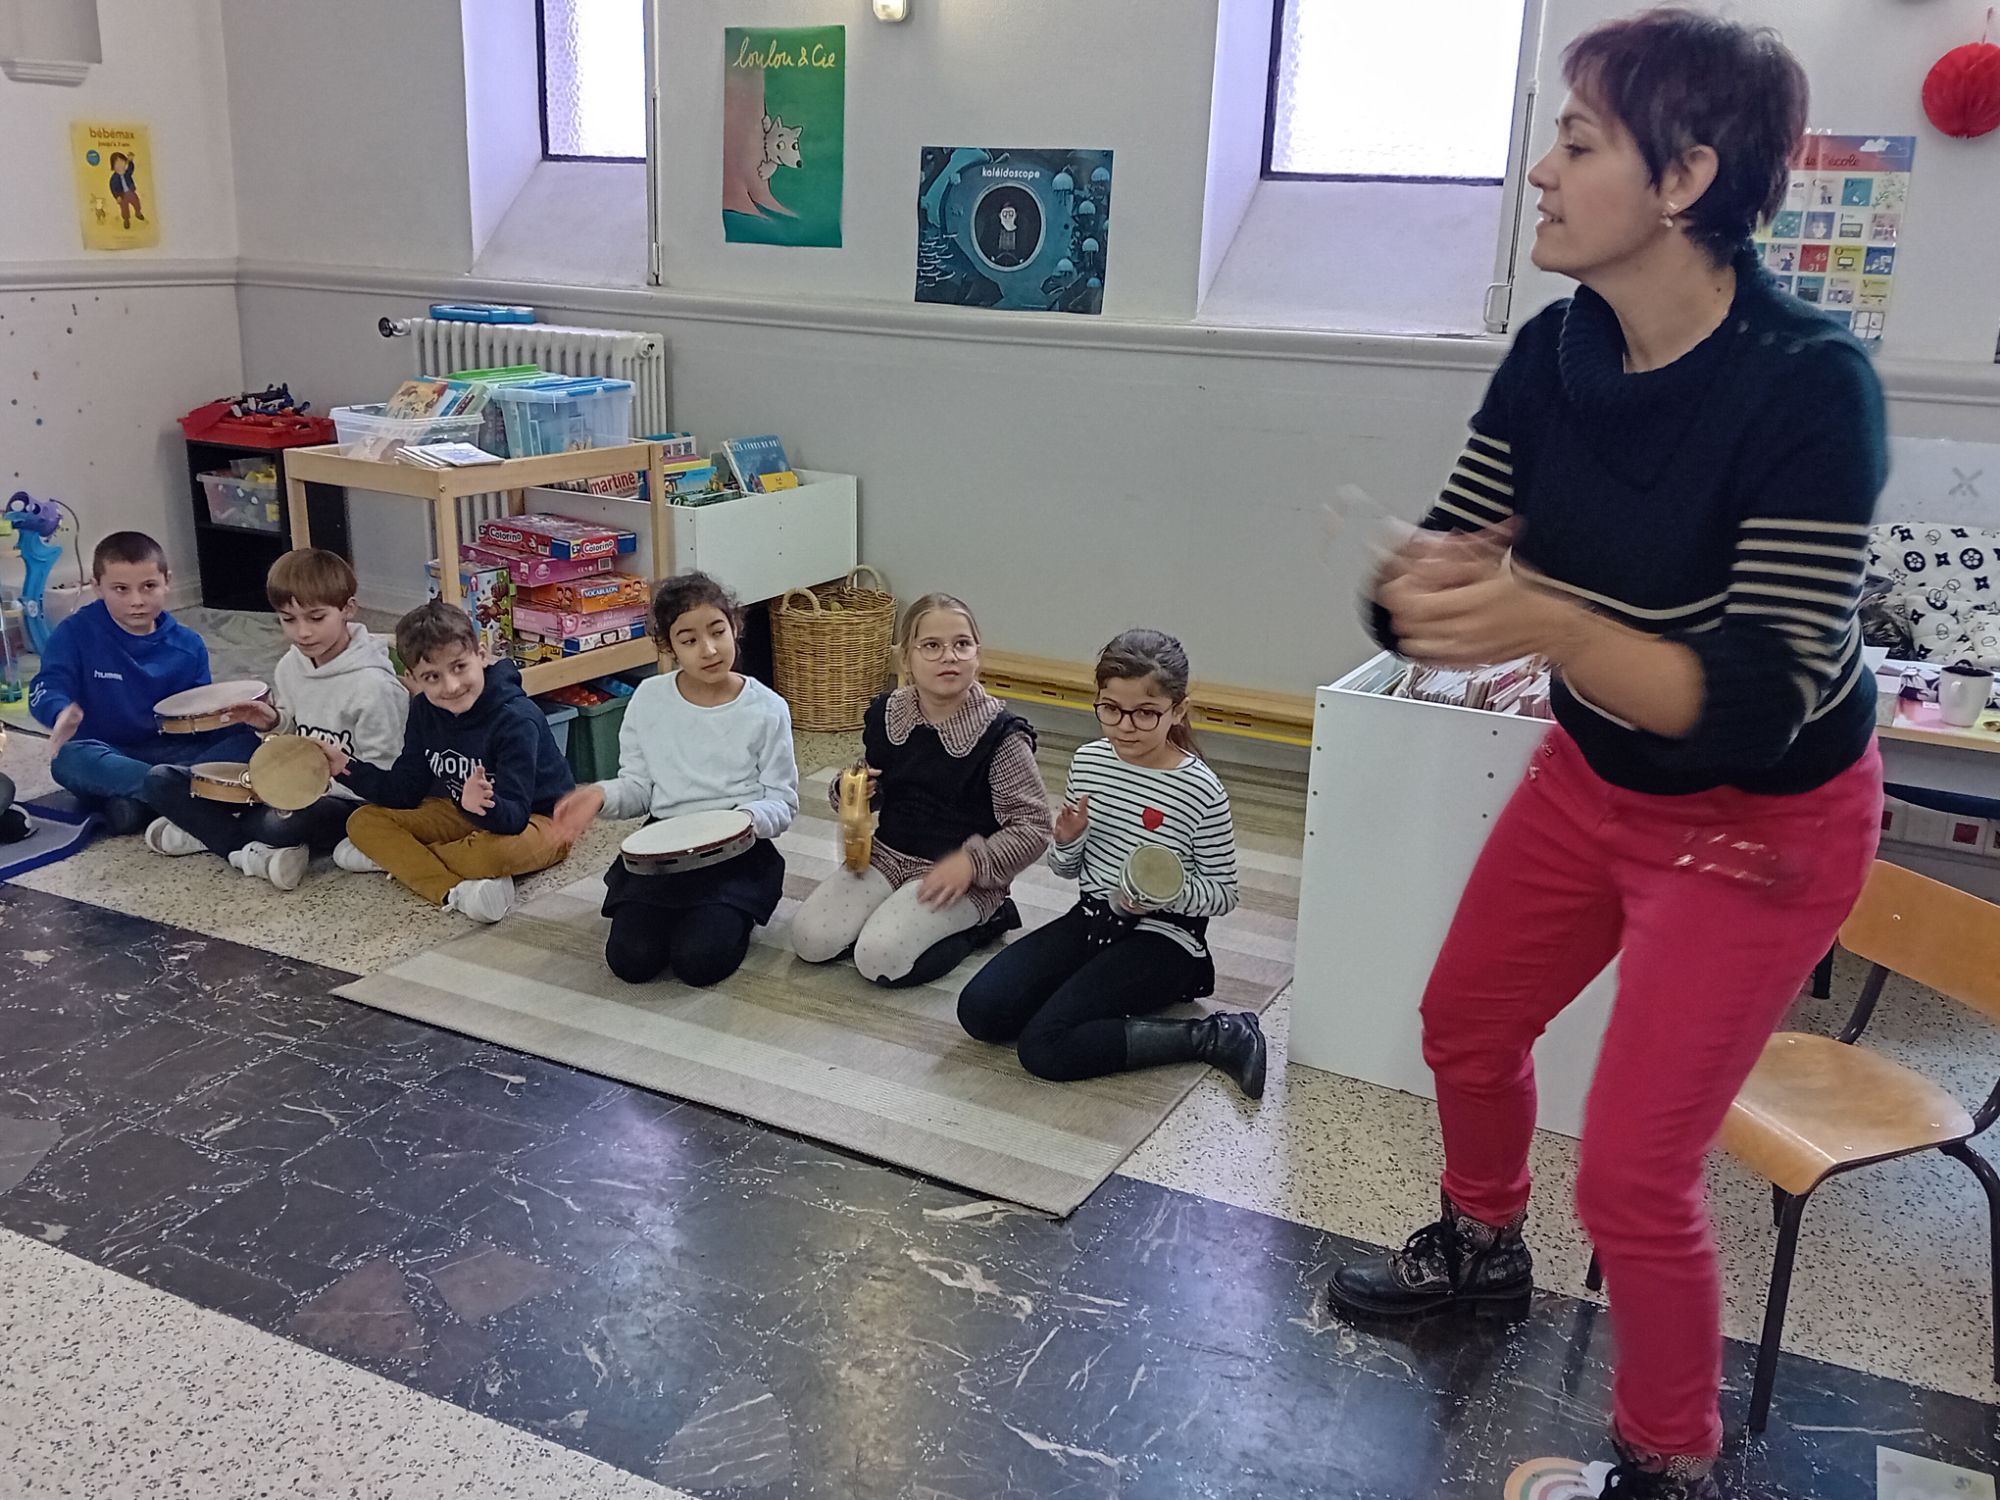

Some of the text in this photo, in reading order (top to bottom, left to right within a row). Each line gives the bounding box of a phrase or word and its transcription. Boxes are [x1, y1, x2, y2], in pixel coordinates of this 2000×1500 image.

[733, 36, 836, 69] loulou & Cie
[982, 166, 1040, 181] kaléidoscope
[591, 472, 637, 496] martine
[489, 528, 522, 541] Colorino
[583, 540, 613, 552] Colorino
